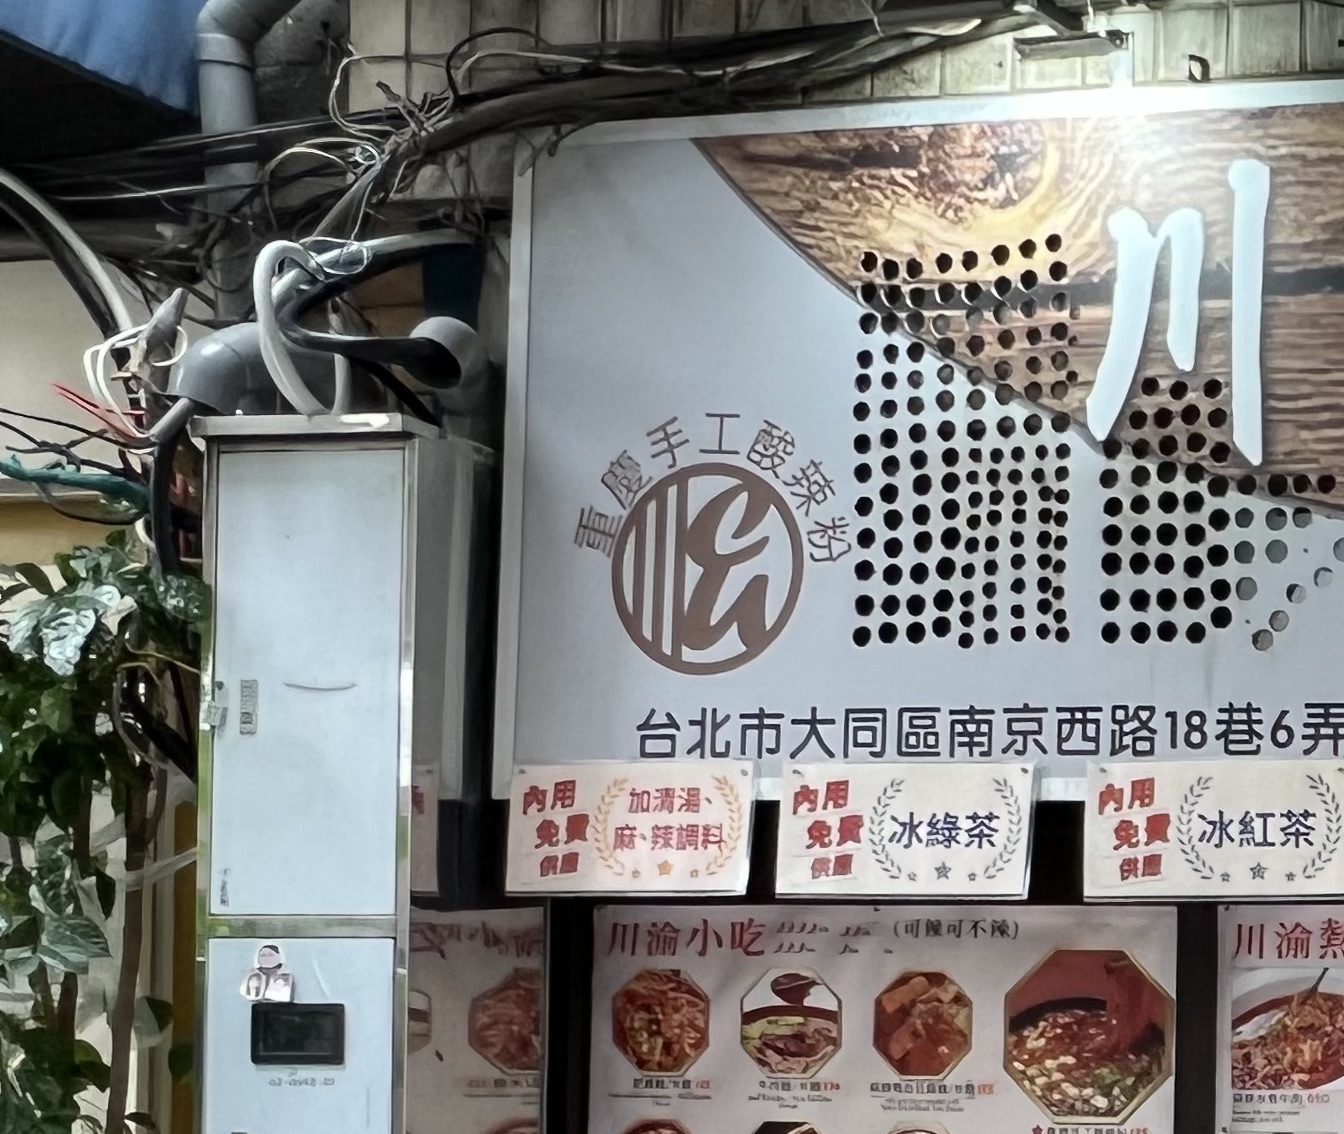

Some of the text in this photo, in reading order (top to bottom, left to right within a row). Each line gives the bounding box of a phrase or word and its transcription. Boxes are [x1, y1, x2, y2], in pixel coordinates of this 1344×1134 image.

[573, 412, 852, 563] 重慶手工酸辣粉
[887, 811, 1001, 851] 冰綠茶
[1197, 809, 1318, 850] 冰紅茶
[607, 917, 767, 958] 川渝小吃
